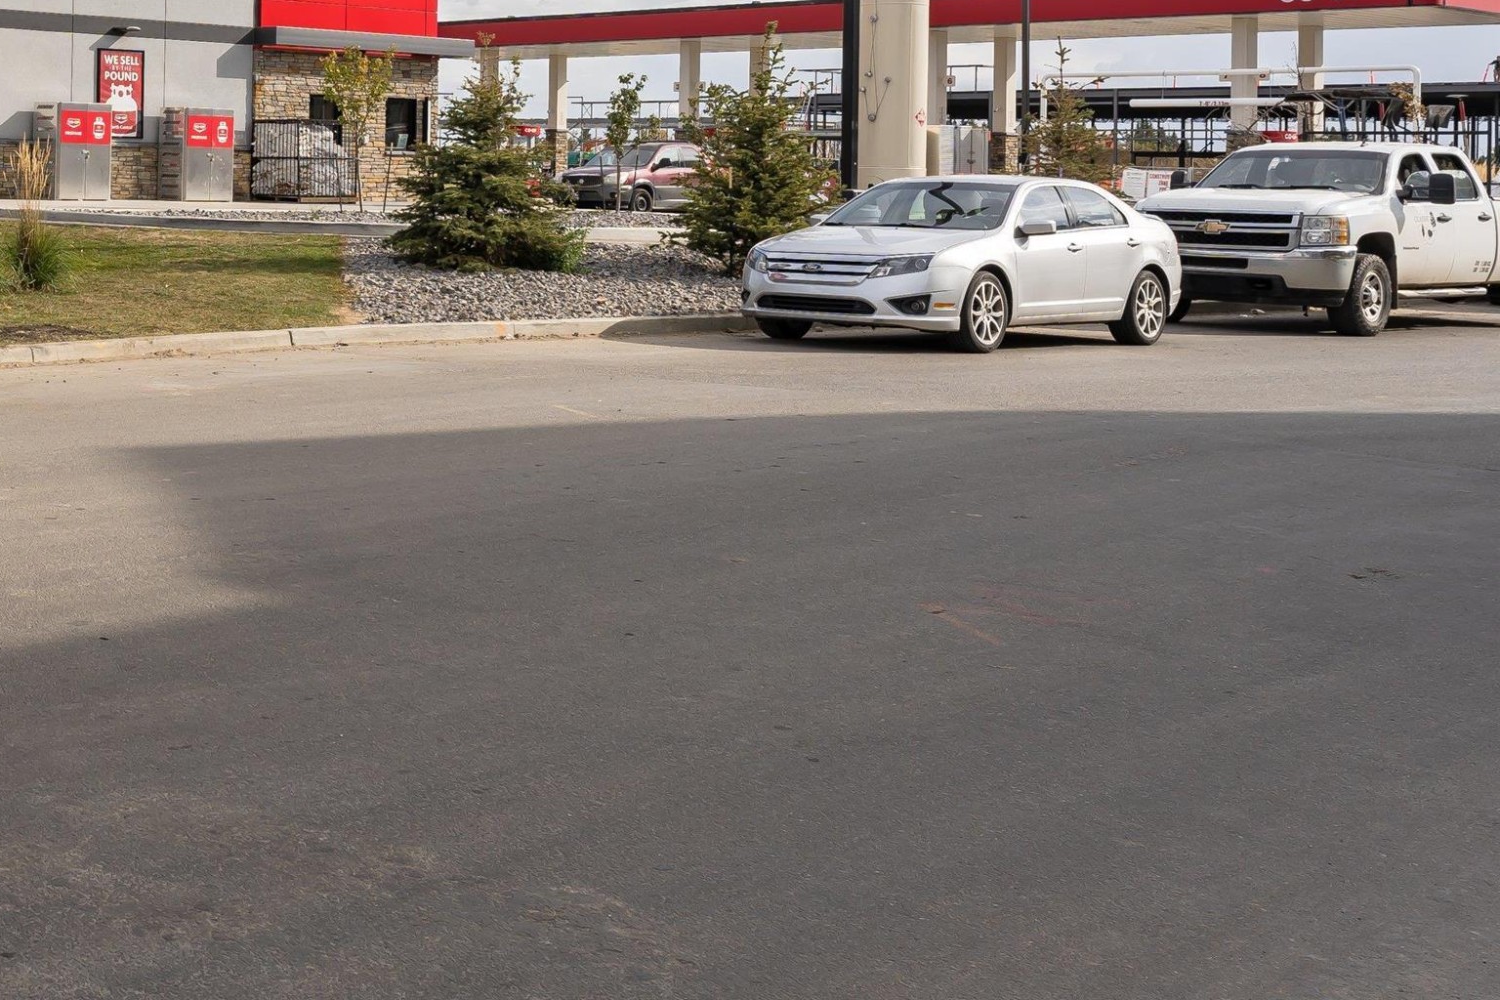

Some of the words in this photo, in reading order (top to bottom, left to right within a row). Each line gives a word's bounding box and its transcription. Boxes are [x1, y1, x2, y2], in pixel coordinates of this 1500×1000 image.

[104, 54, 119, 65] WE
[120, 55, 140, 66] SELL
[104, 71, 139, 82] POUND
